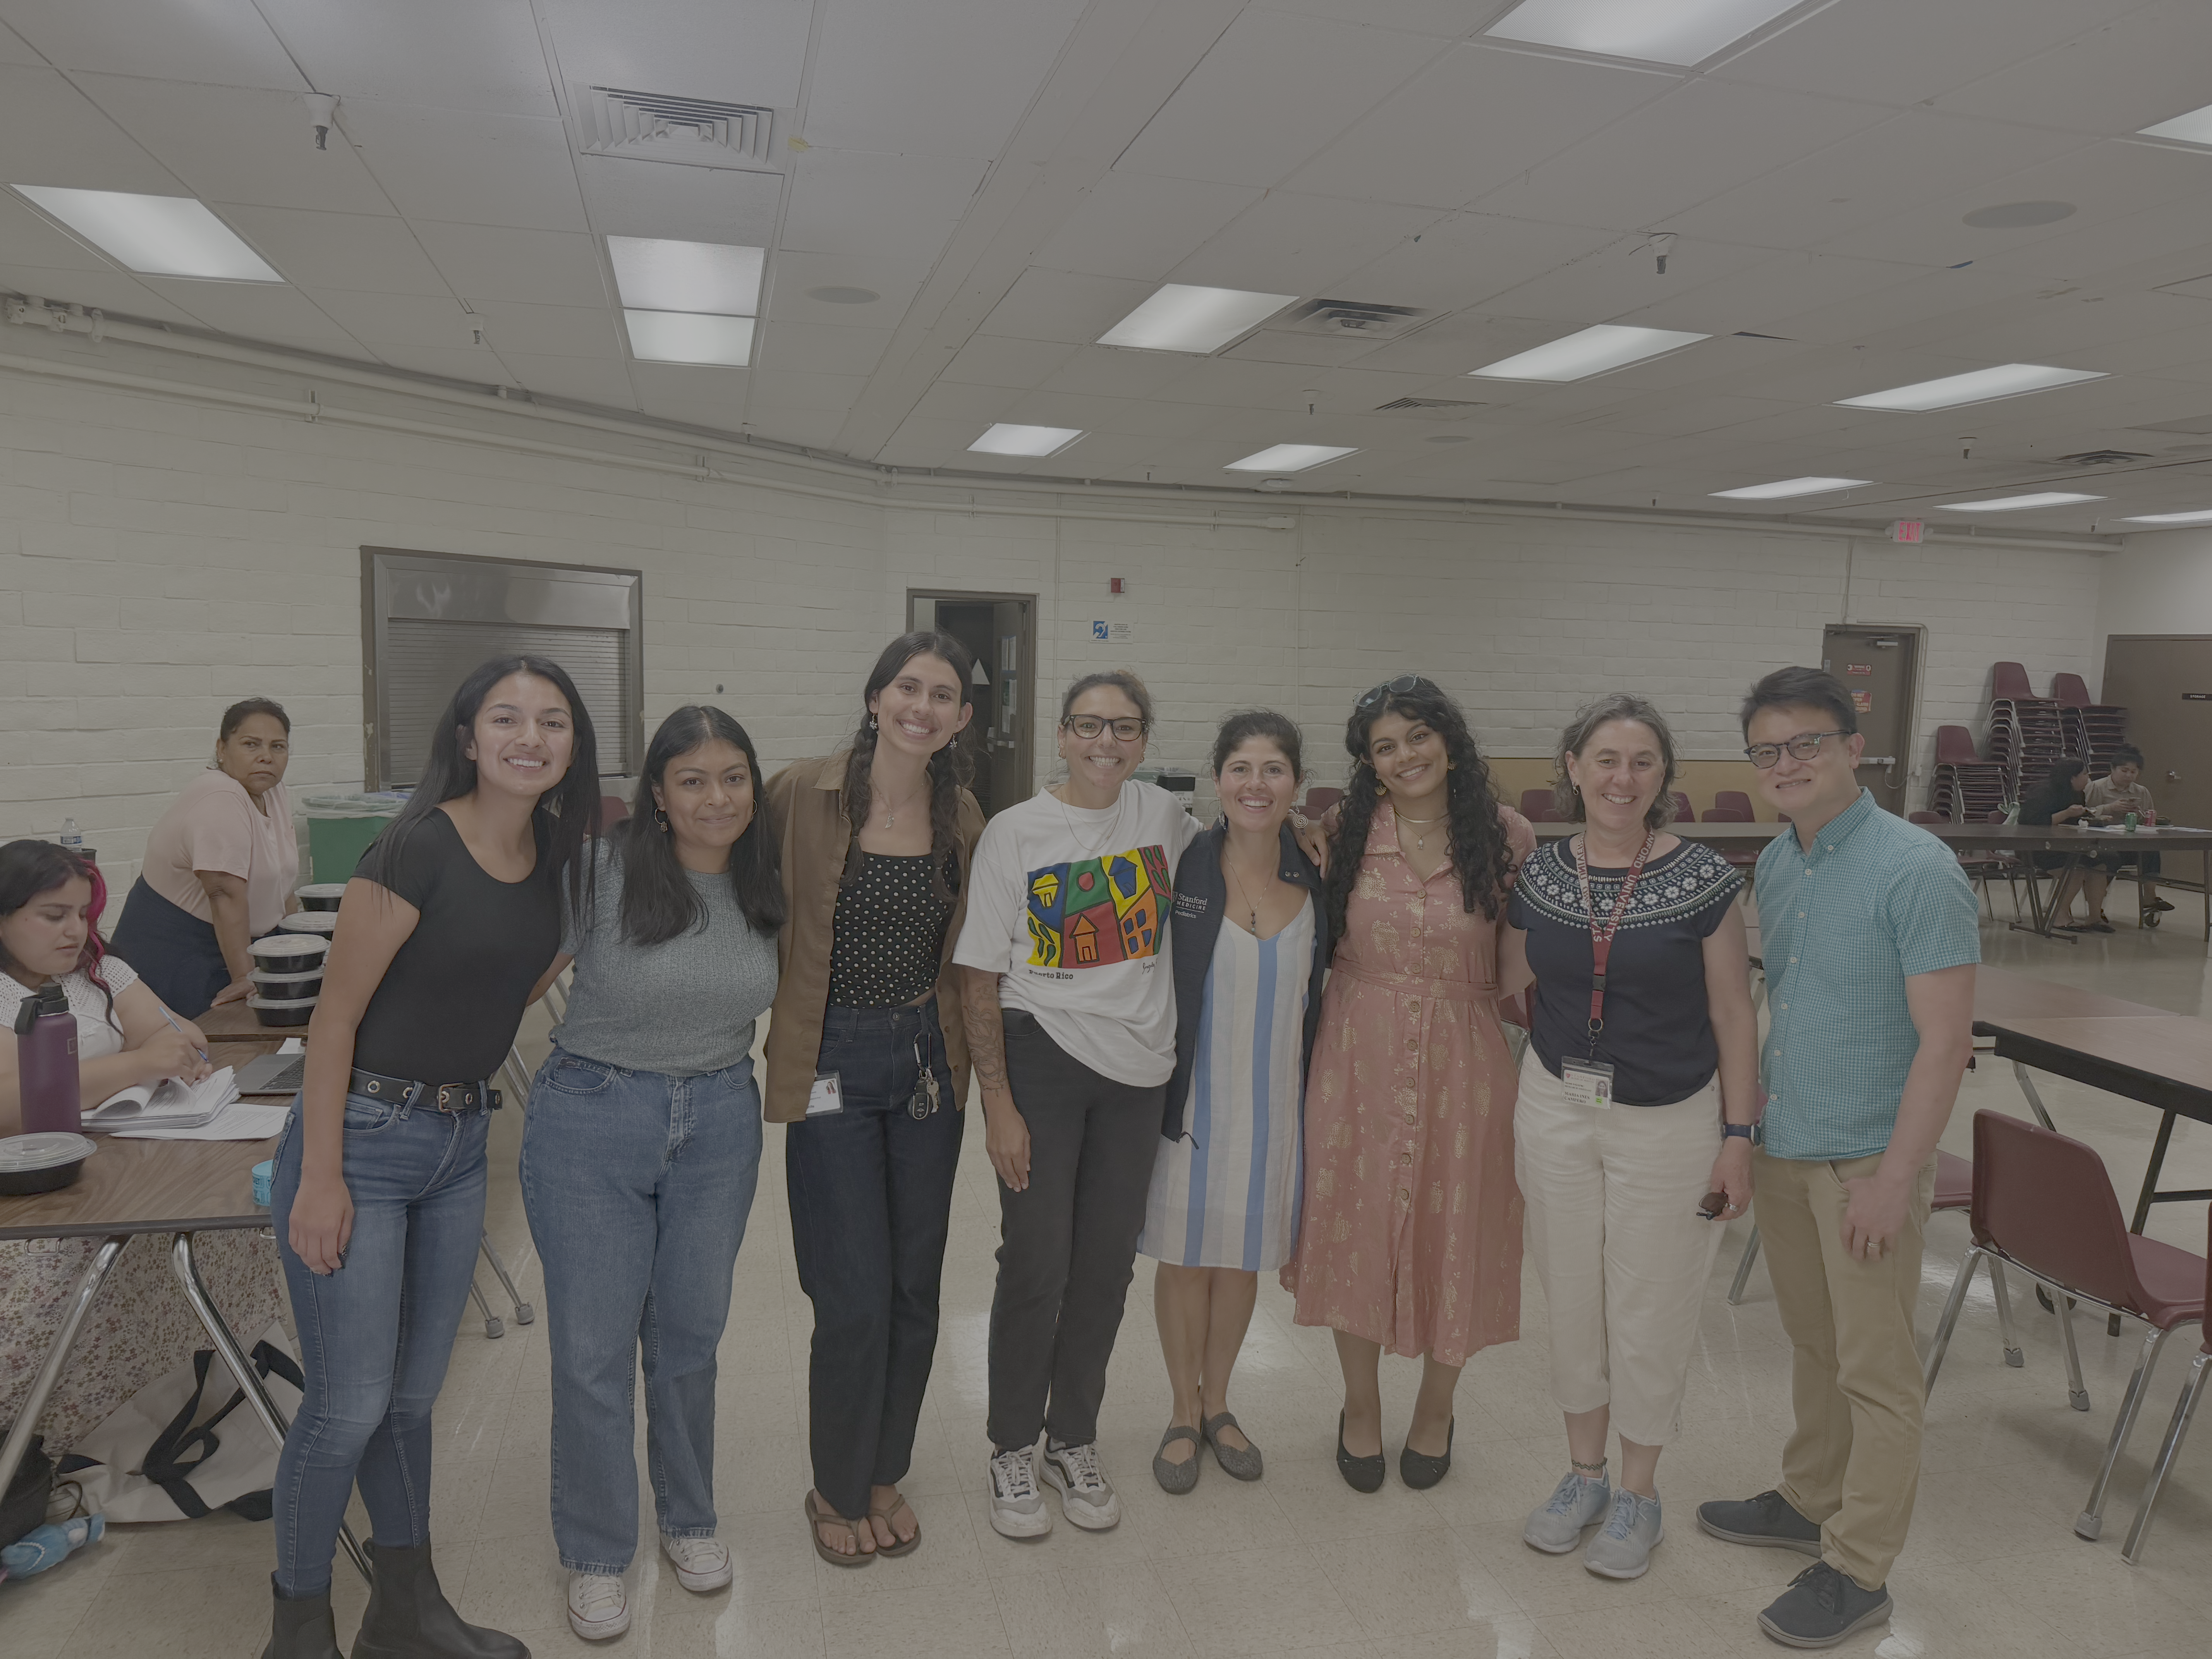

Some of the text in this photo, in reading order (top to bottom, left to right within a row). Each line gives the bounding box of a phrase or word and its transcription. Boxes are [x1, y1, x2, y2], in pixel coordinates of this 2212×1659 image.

[1898, 522, 1921, 542] EXIT
[1603, 826, 1655, 941] ANFORD UNIVERSITY
[1176, 900, 1206, 910] MEDICINE
[1178, 893, 1207, 905] Stanford
[1175, 910, 1197, 919] Pediatrics
